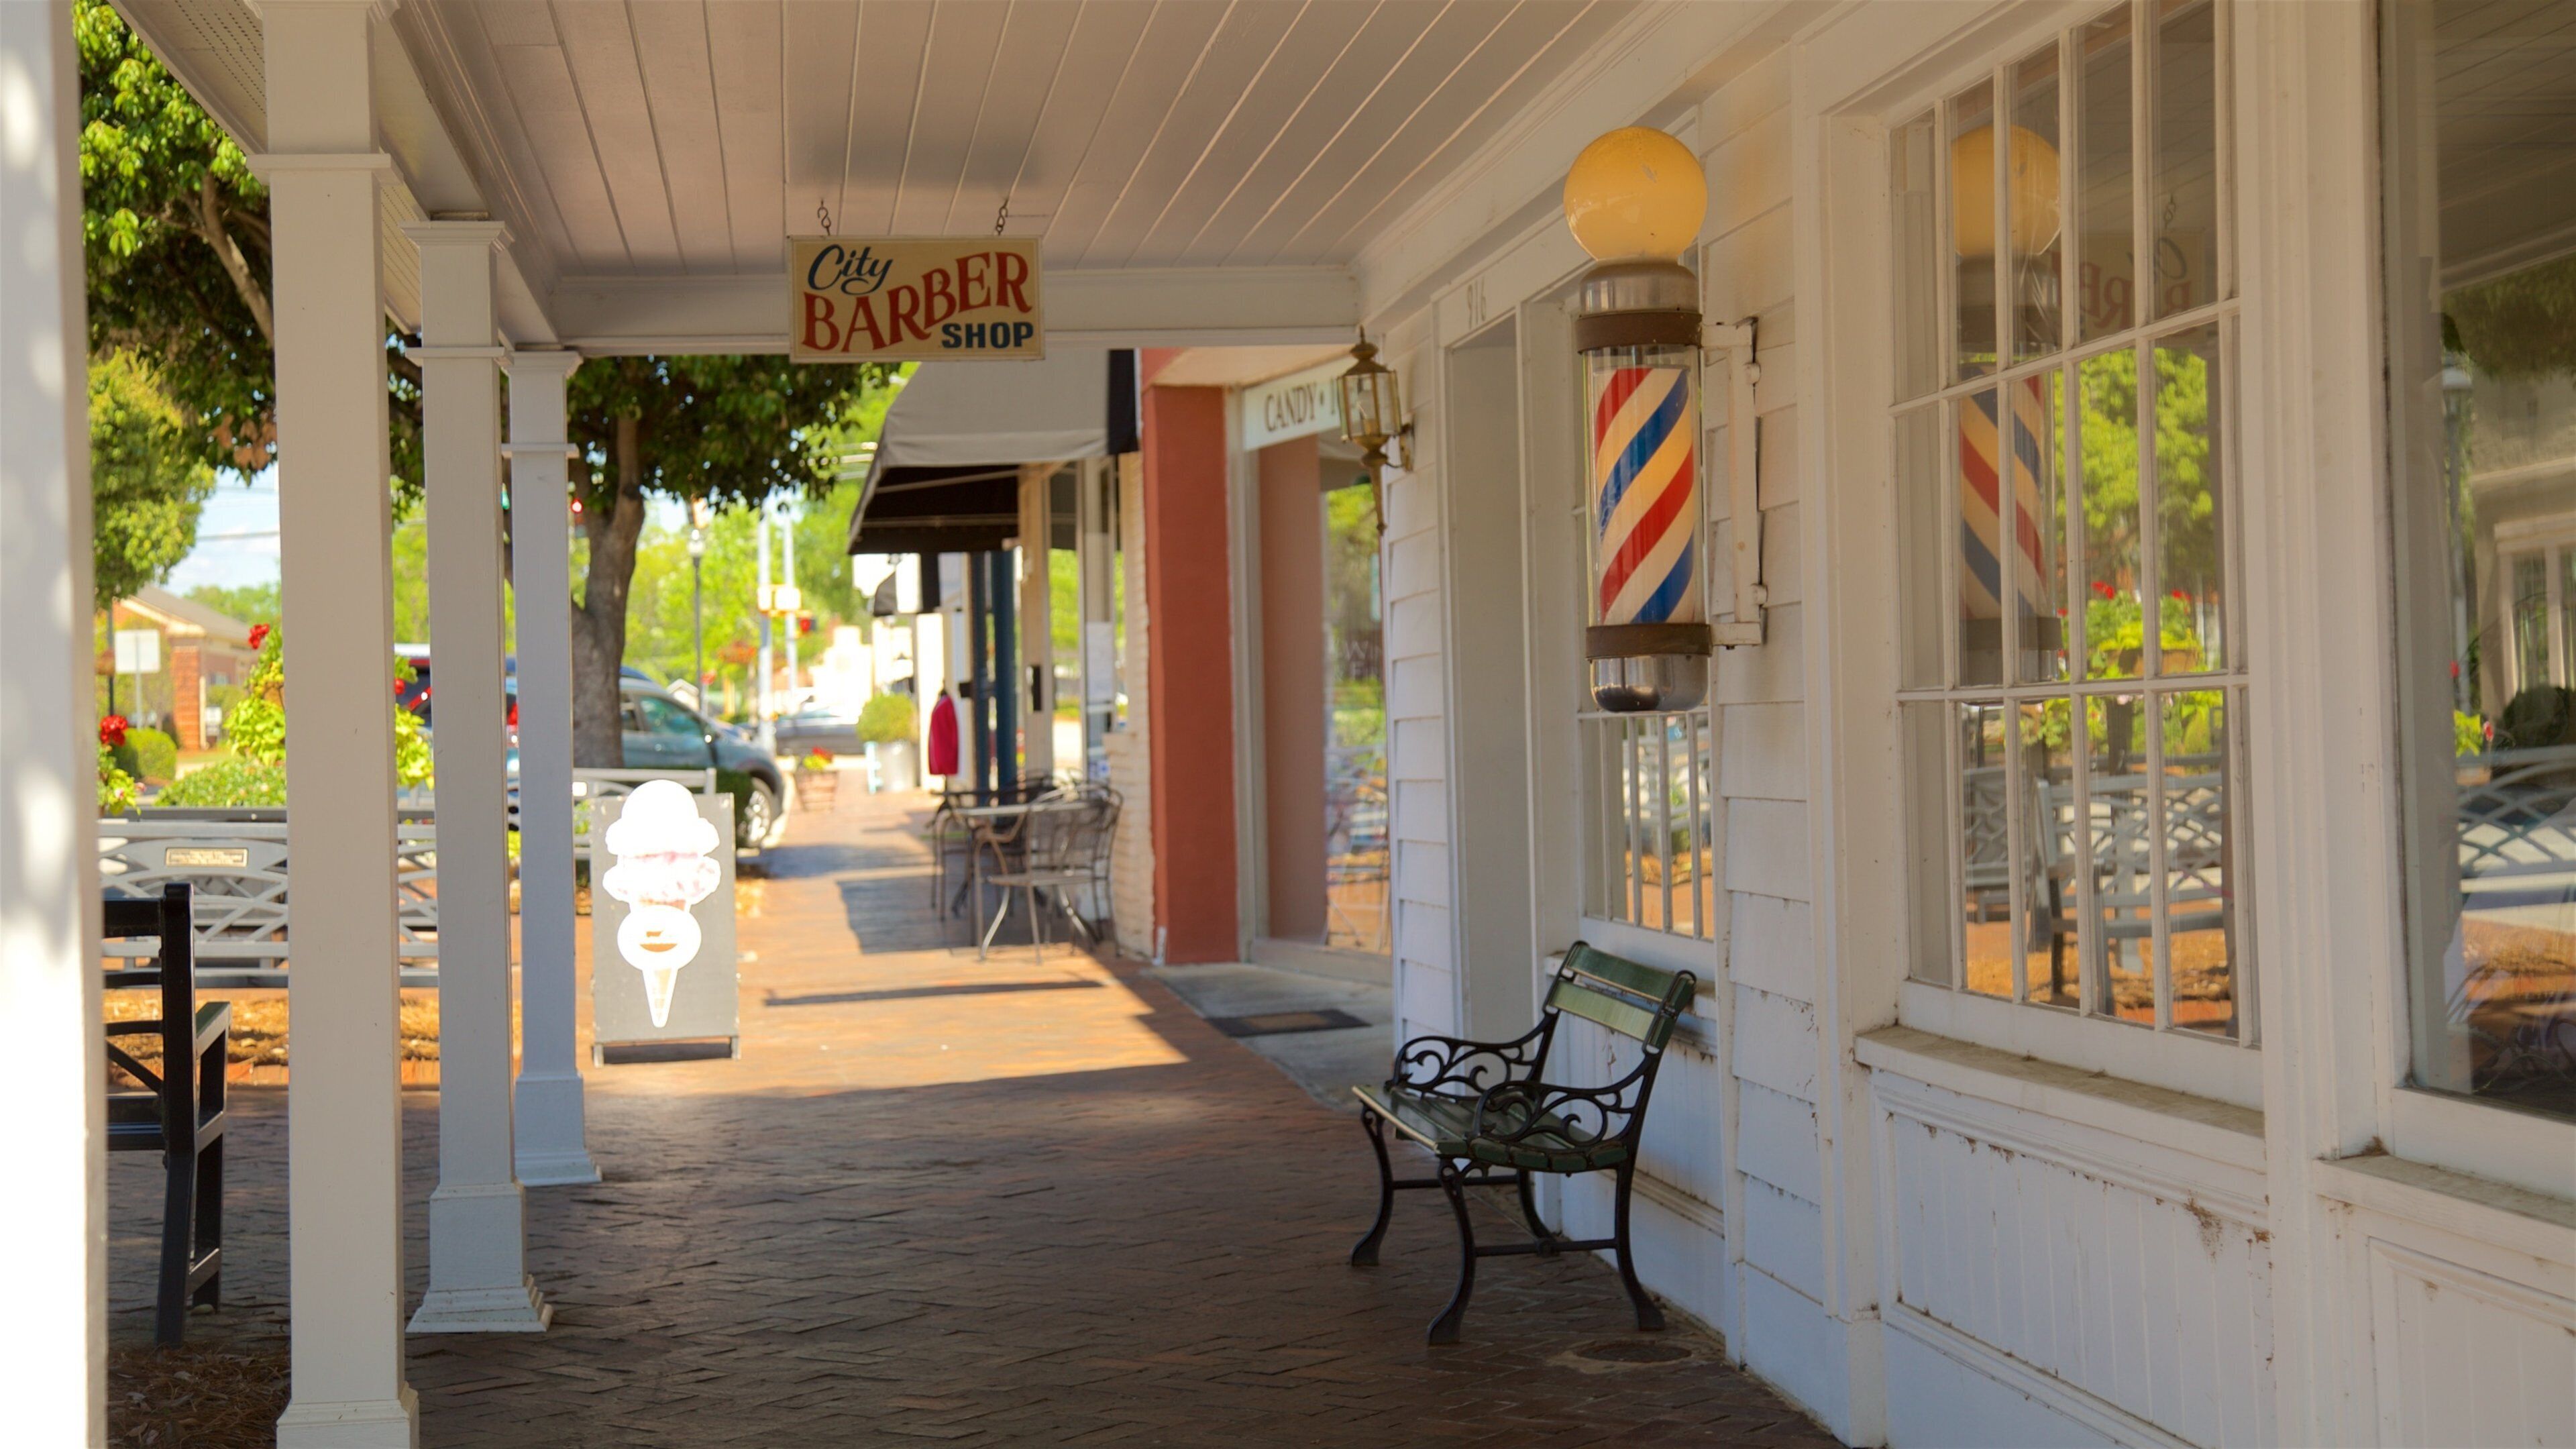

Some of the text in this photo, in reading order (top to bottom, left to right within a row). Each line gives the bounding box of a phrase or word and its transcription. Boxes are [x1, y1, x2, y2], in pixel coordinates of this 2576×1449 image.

[807, 244, 893, 296] City
[802, 252, 1033, 352] BARBER
[941, 321, 1034, 349] SHOP
[1264, 381, 1317, 433] CANDY
